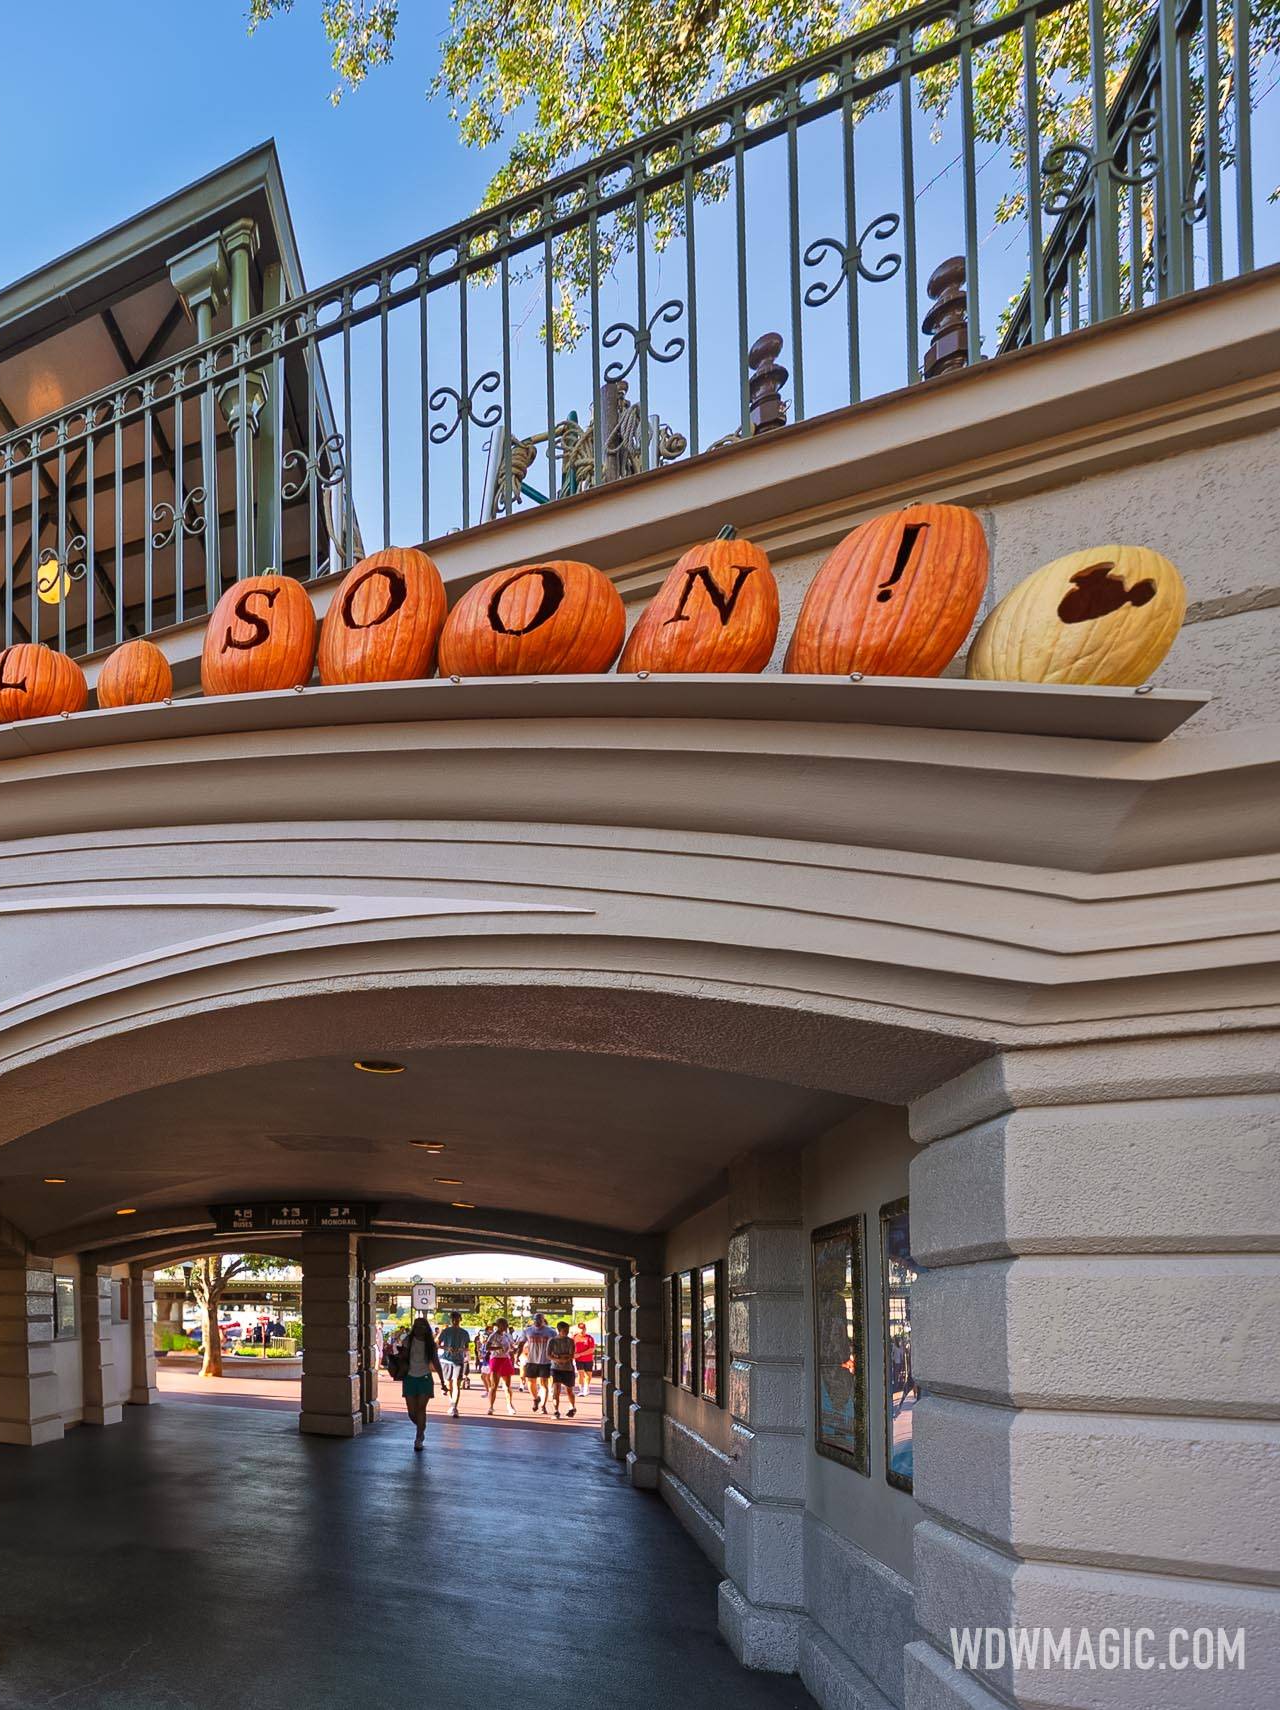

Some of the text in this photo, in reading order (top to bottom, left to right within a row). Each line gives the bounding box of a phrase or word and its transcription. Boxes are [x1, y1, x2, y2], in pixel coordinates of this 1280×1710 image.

[220, 522, 931, 654] SOON!
[271, 1218, 309, 1226] FERRYBOAT
[321, 1218, 357, 1226] MONORAIL
[417, 1288, 431, 1296] EXIT
